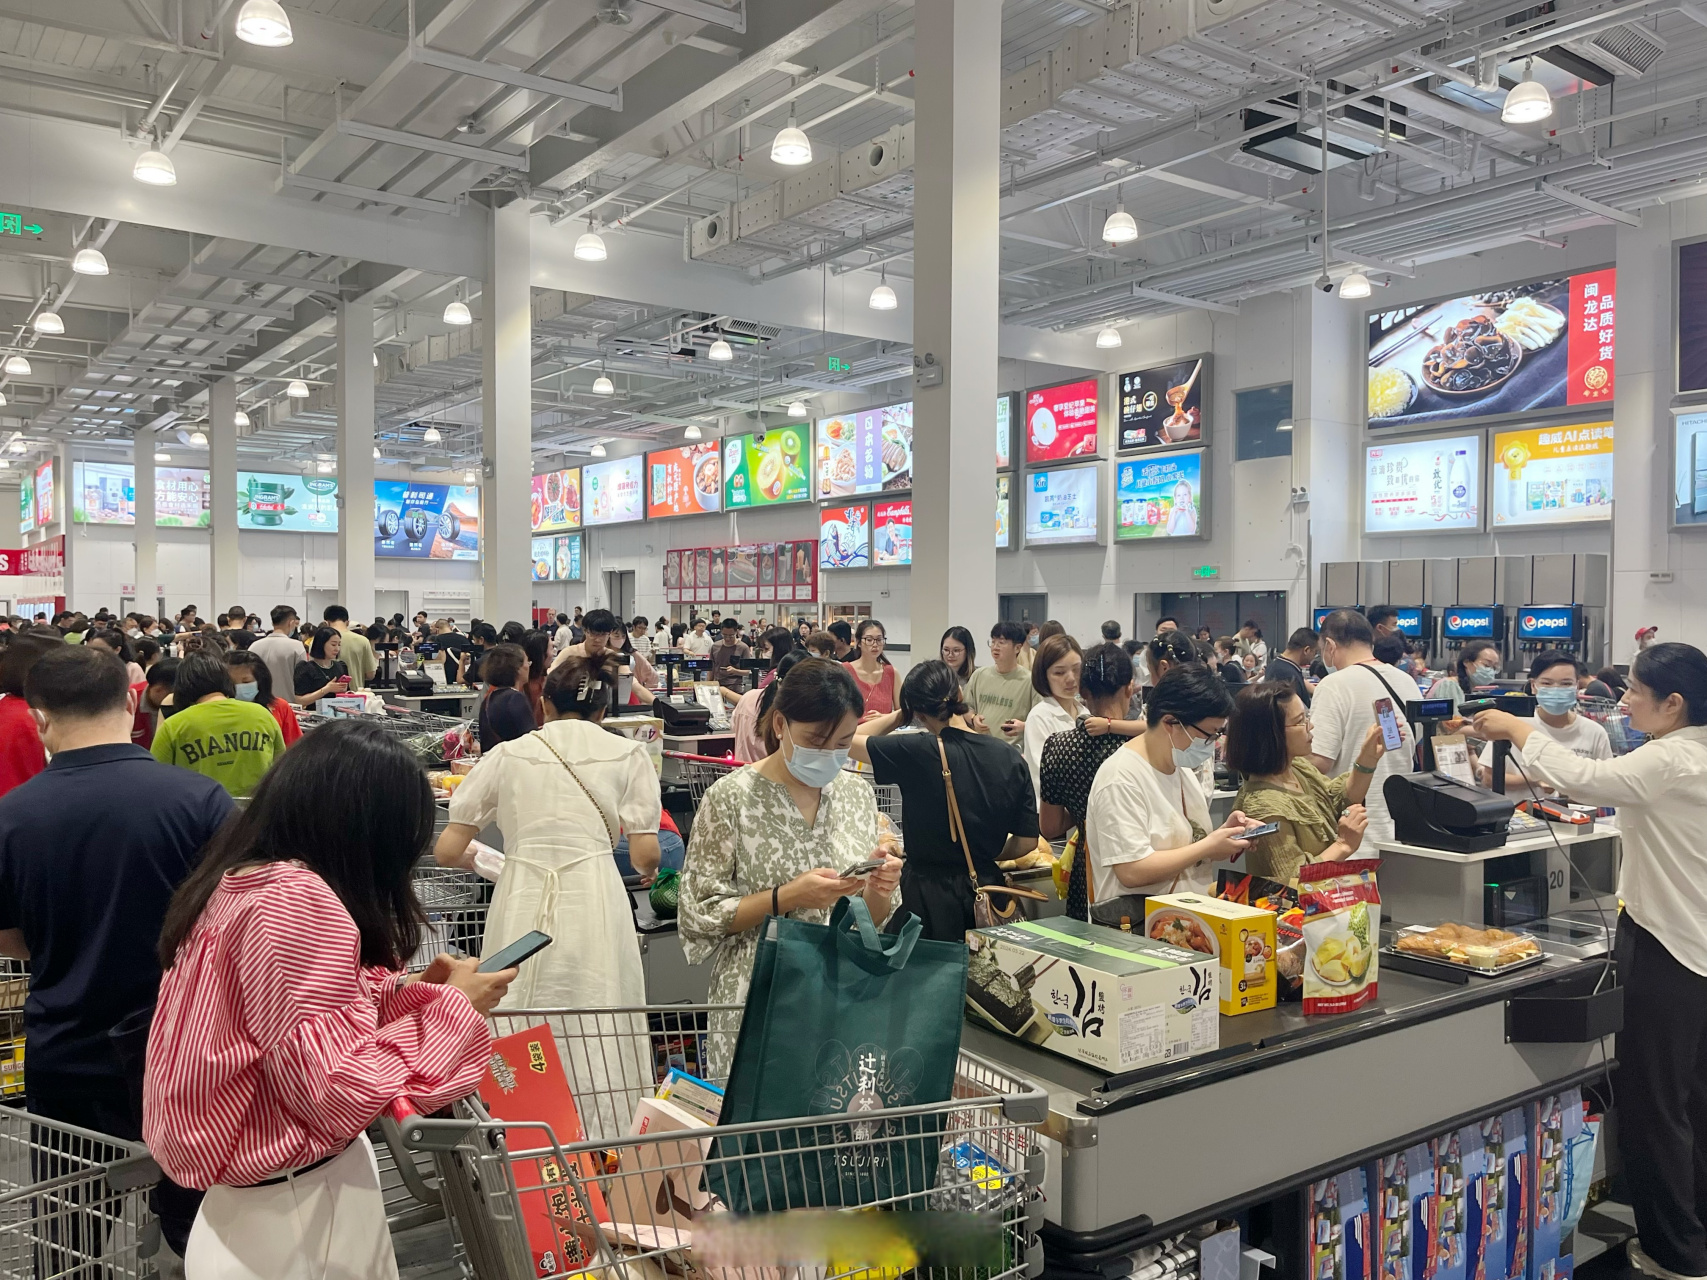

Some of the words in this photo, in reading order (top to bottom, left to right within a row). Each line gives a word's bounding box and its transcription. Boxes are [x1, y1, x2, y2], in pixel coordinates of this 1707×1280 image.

[1583, 283, 1598, 332] 闽龙达
[1599, 295, 1614, 361] 品质好货
[864, 416, 874, 480] 日本名物
[1461, 617, 1489, 628] pepsi
[1537, 617, 1567, 628] pepsi
[1549, 869, 1564, 889] 20
